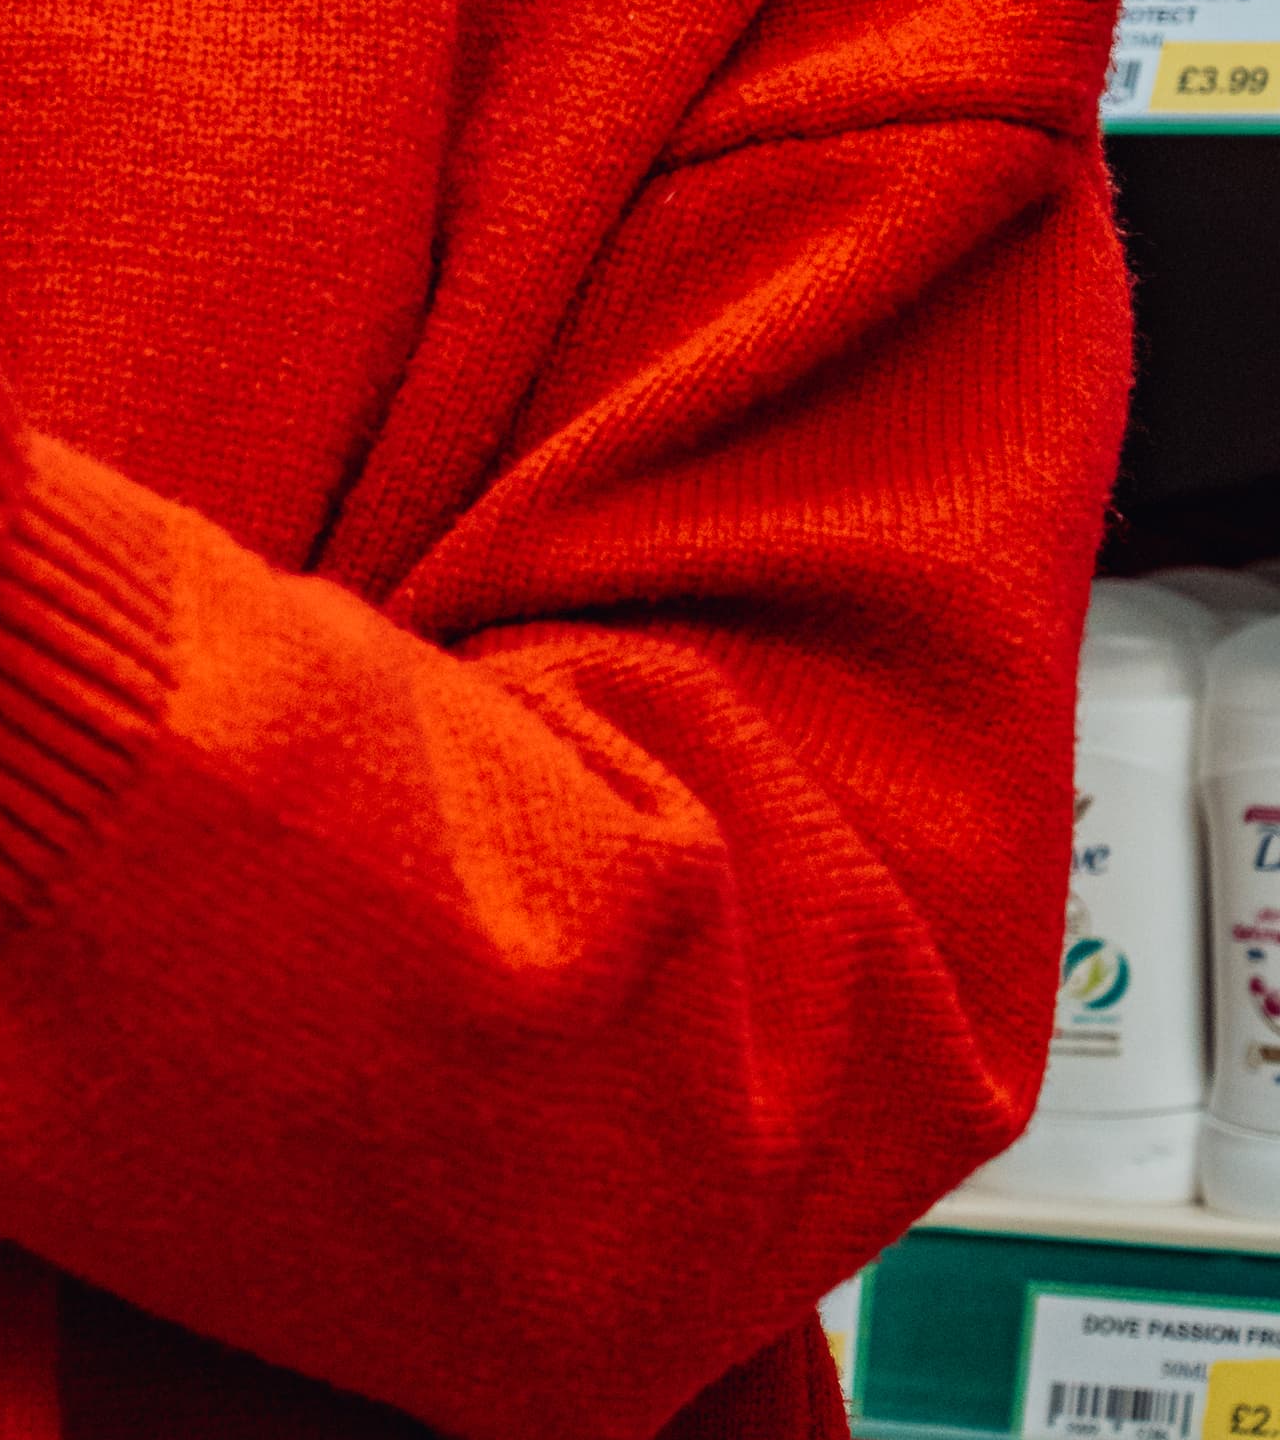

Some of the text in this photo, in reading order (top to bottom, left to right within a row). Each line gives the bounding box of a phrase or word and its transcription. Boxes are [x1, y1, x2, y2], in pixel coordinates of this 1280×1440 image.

[1175, 64, 1271, 96] £3.99
[1081, 1313, 1143, 1339] DOVE
[1146, 1318, 1240, 1345] PASSION
